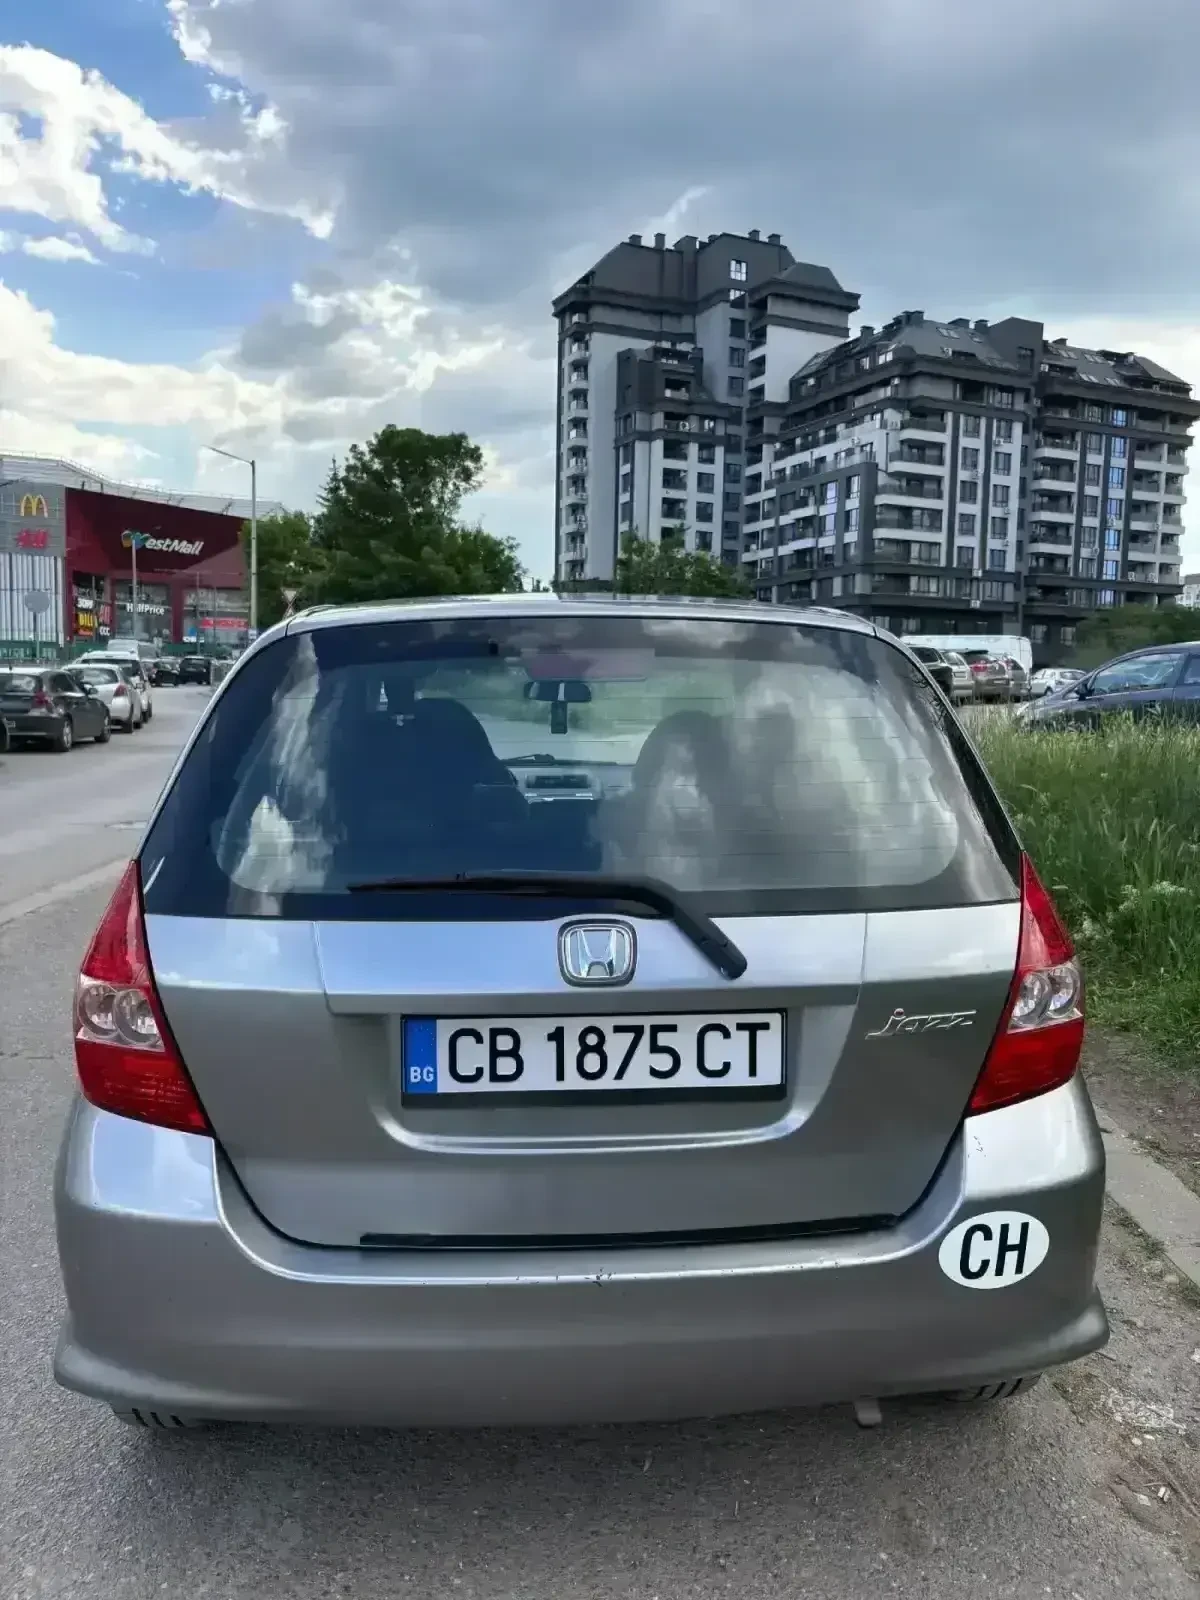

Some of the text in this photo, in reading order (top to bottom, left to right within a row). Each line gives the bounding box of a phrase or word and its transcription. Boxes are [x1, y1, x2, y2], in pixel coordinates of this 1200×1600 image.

[126, 602, 165, 615] HlfPrice
[448, 1022, 771, 1084] CB 1875 CT
[410, 1066, 435, 1084] BG
[959, 1221, 1030, 1280] CH
